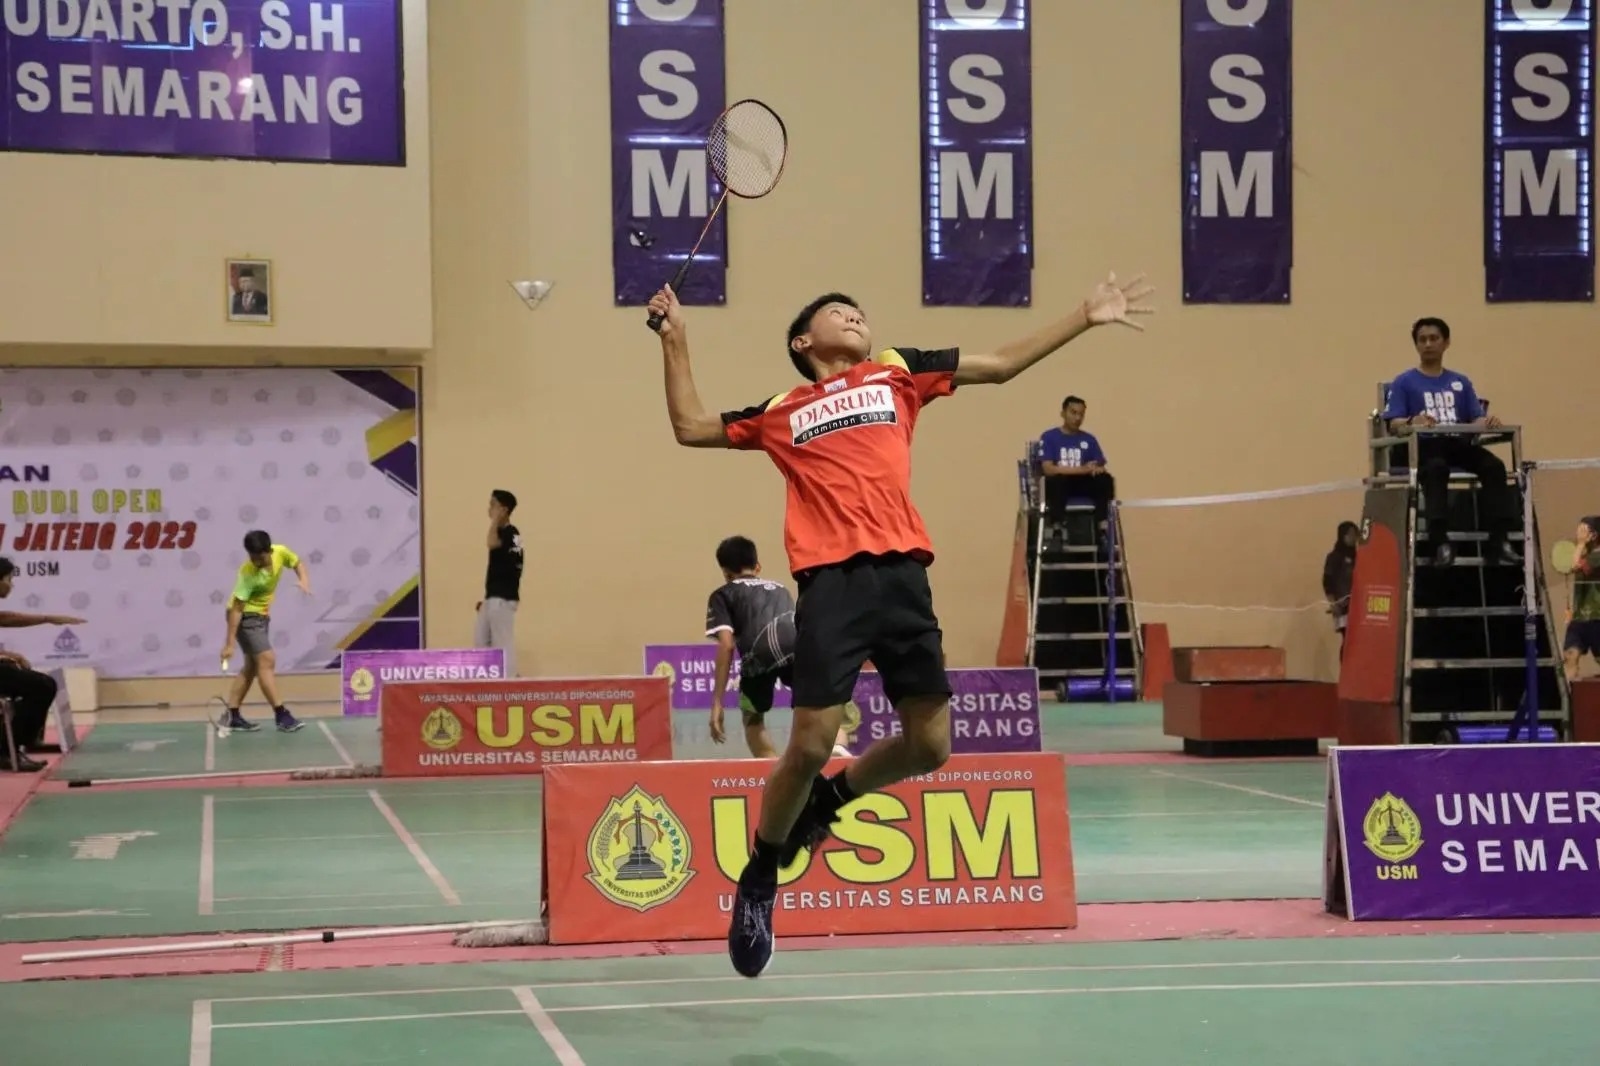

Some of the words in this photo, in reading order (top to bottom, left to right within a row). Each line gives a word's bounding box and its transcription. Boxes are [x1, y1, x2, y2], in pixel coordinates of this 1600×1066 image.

[260, 0, 361, 53] S.H.
[16, 62, 363, 126] SEMARANG
[797, 390, 886, 428] DJARUM
[860, 411, 886, 423] Club
[802, 417, 856, 440] Badminton
[12, 489, 79, 515] BUDI
[92, 488, 163, 514] OPEN
[123, 520, 198, 550] 2023
[27, 562, 60, 577] USM
[380, 665, 501, 681] UNIVERSITAS
[504, 690, 567, 702] UNIVERSITAS
[569, 689, 635, 701] DIPONEGORO
[475, 703, 636, 748] USM
[418, 750, 536, 766] UNIVERSITAS
[541, 748, 637, 764] SEMARANG
[711, 778, 766, 790] YAYASA
[938, 769, 1034, 784] DIPONEGORO
[1441, 838, 1600, 874] SEMA
[1376, 864, 1418, 880] USM
[900, 884, 1045, 906] SEMARANG
